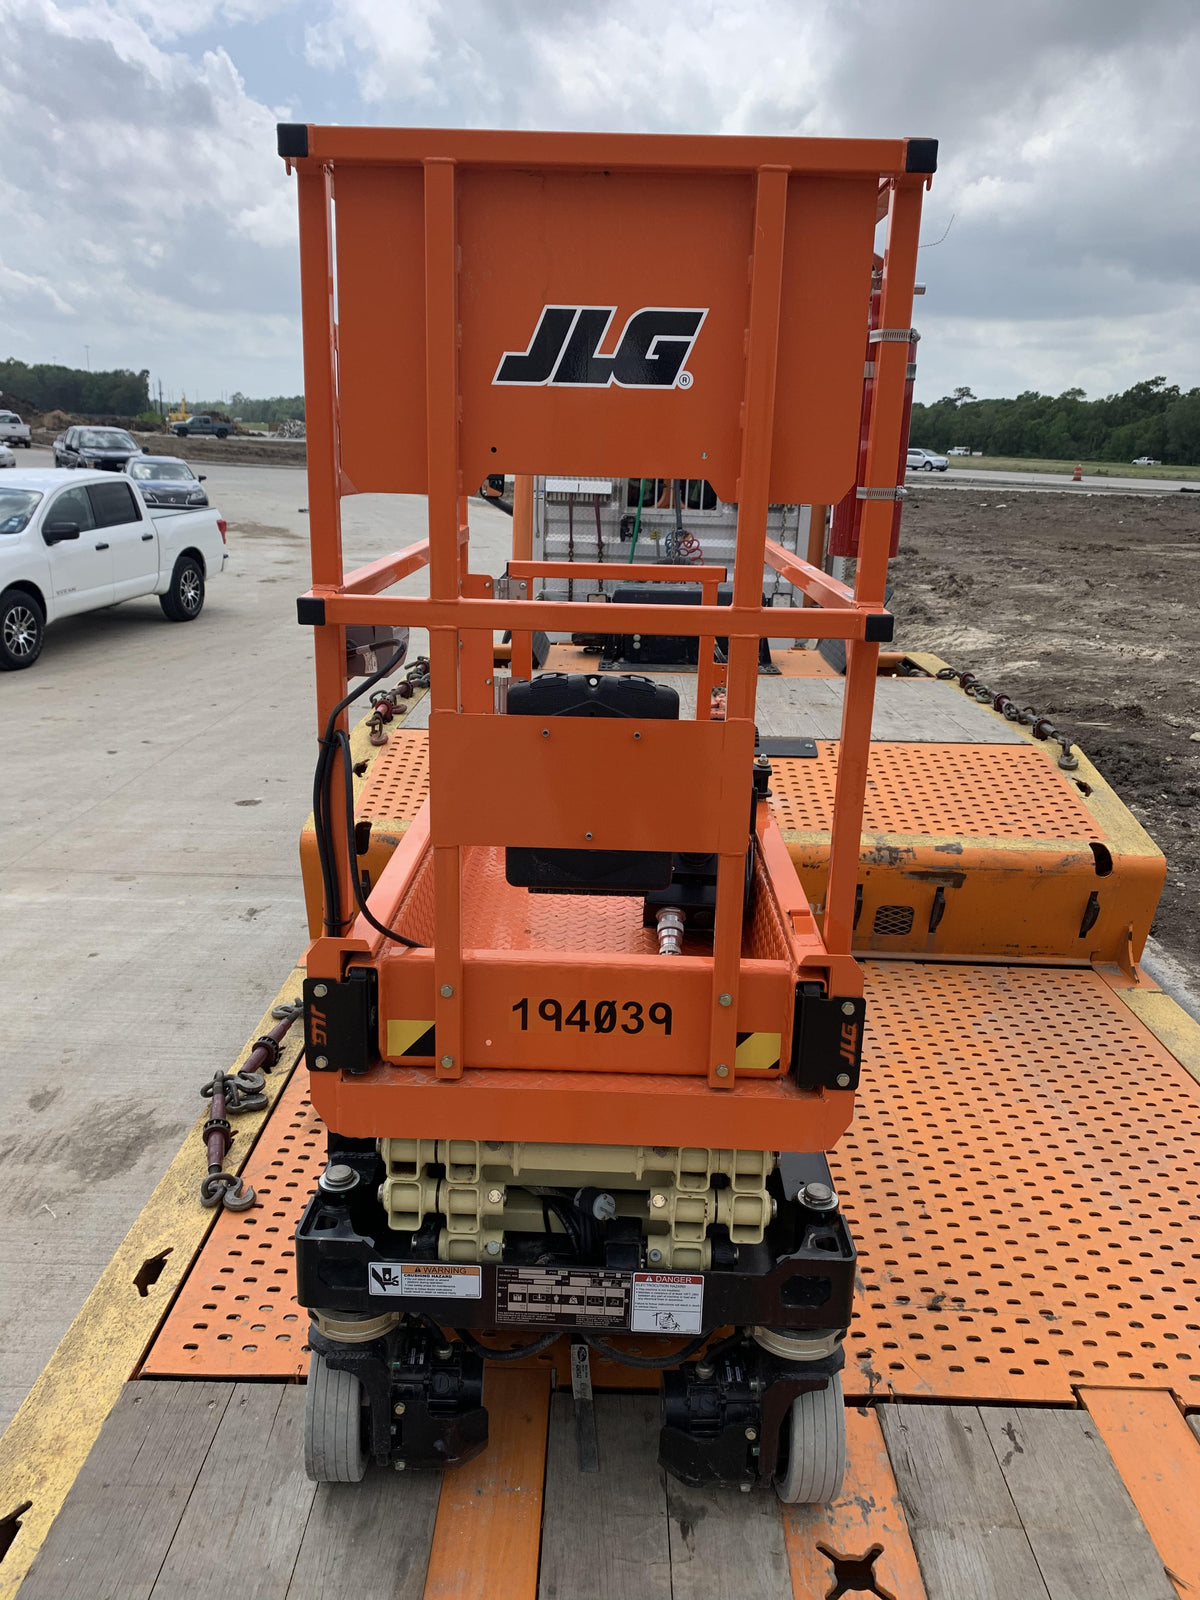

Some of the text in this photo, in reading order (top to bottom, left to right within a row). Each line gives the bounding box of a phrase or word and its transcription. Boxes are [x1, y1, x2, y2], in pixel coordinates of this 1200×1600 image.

[491, 304, 710, 389] JLG
[310, 1003, 328, 1047] JLG
[511, 997, 673, 1036] 194039
[839, 1022, 858, 1067] JLG
[423, 1266, 468, 1275] WARNING
[655, 1275, 692, 1284] DANGER
